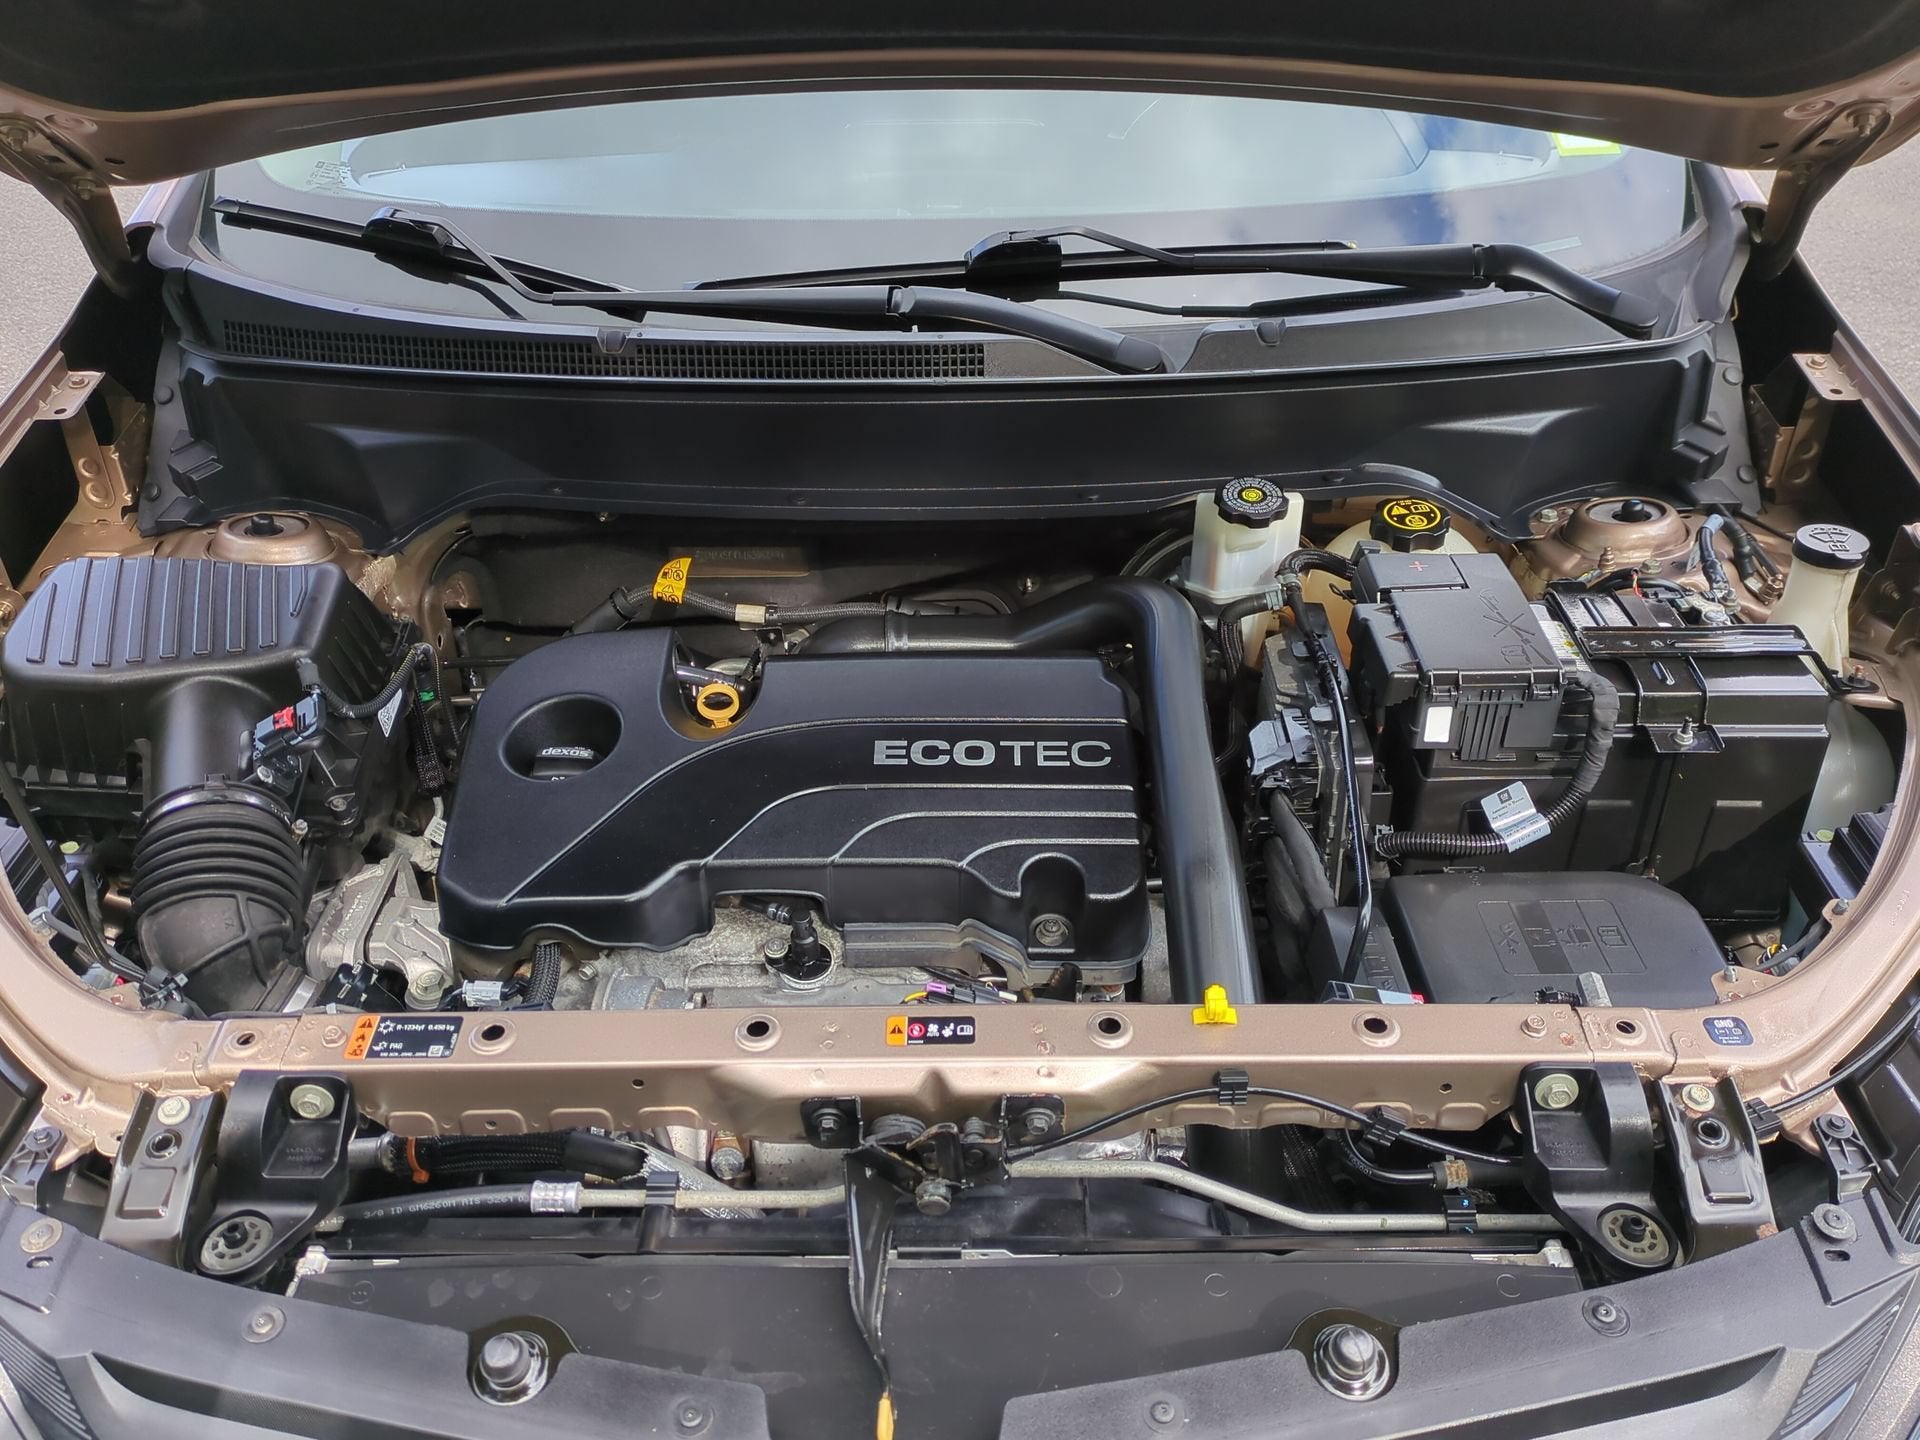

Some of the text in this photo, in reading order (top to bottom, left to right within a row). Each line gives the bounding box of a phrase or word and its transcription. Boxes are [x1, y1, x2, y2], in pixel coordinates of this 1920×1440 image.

[541, 747, 589, 756] dexos
[873, 739, 1112, 767] ECOTEC
[396, 1024, 425, 1032] R-1234yf
[1713, 1019, 1735, 1028] GND
[389, 1042, 404, 1050] PAG
[391, 1205, 403, 1215] ID
